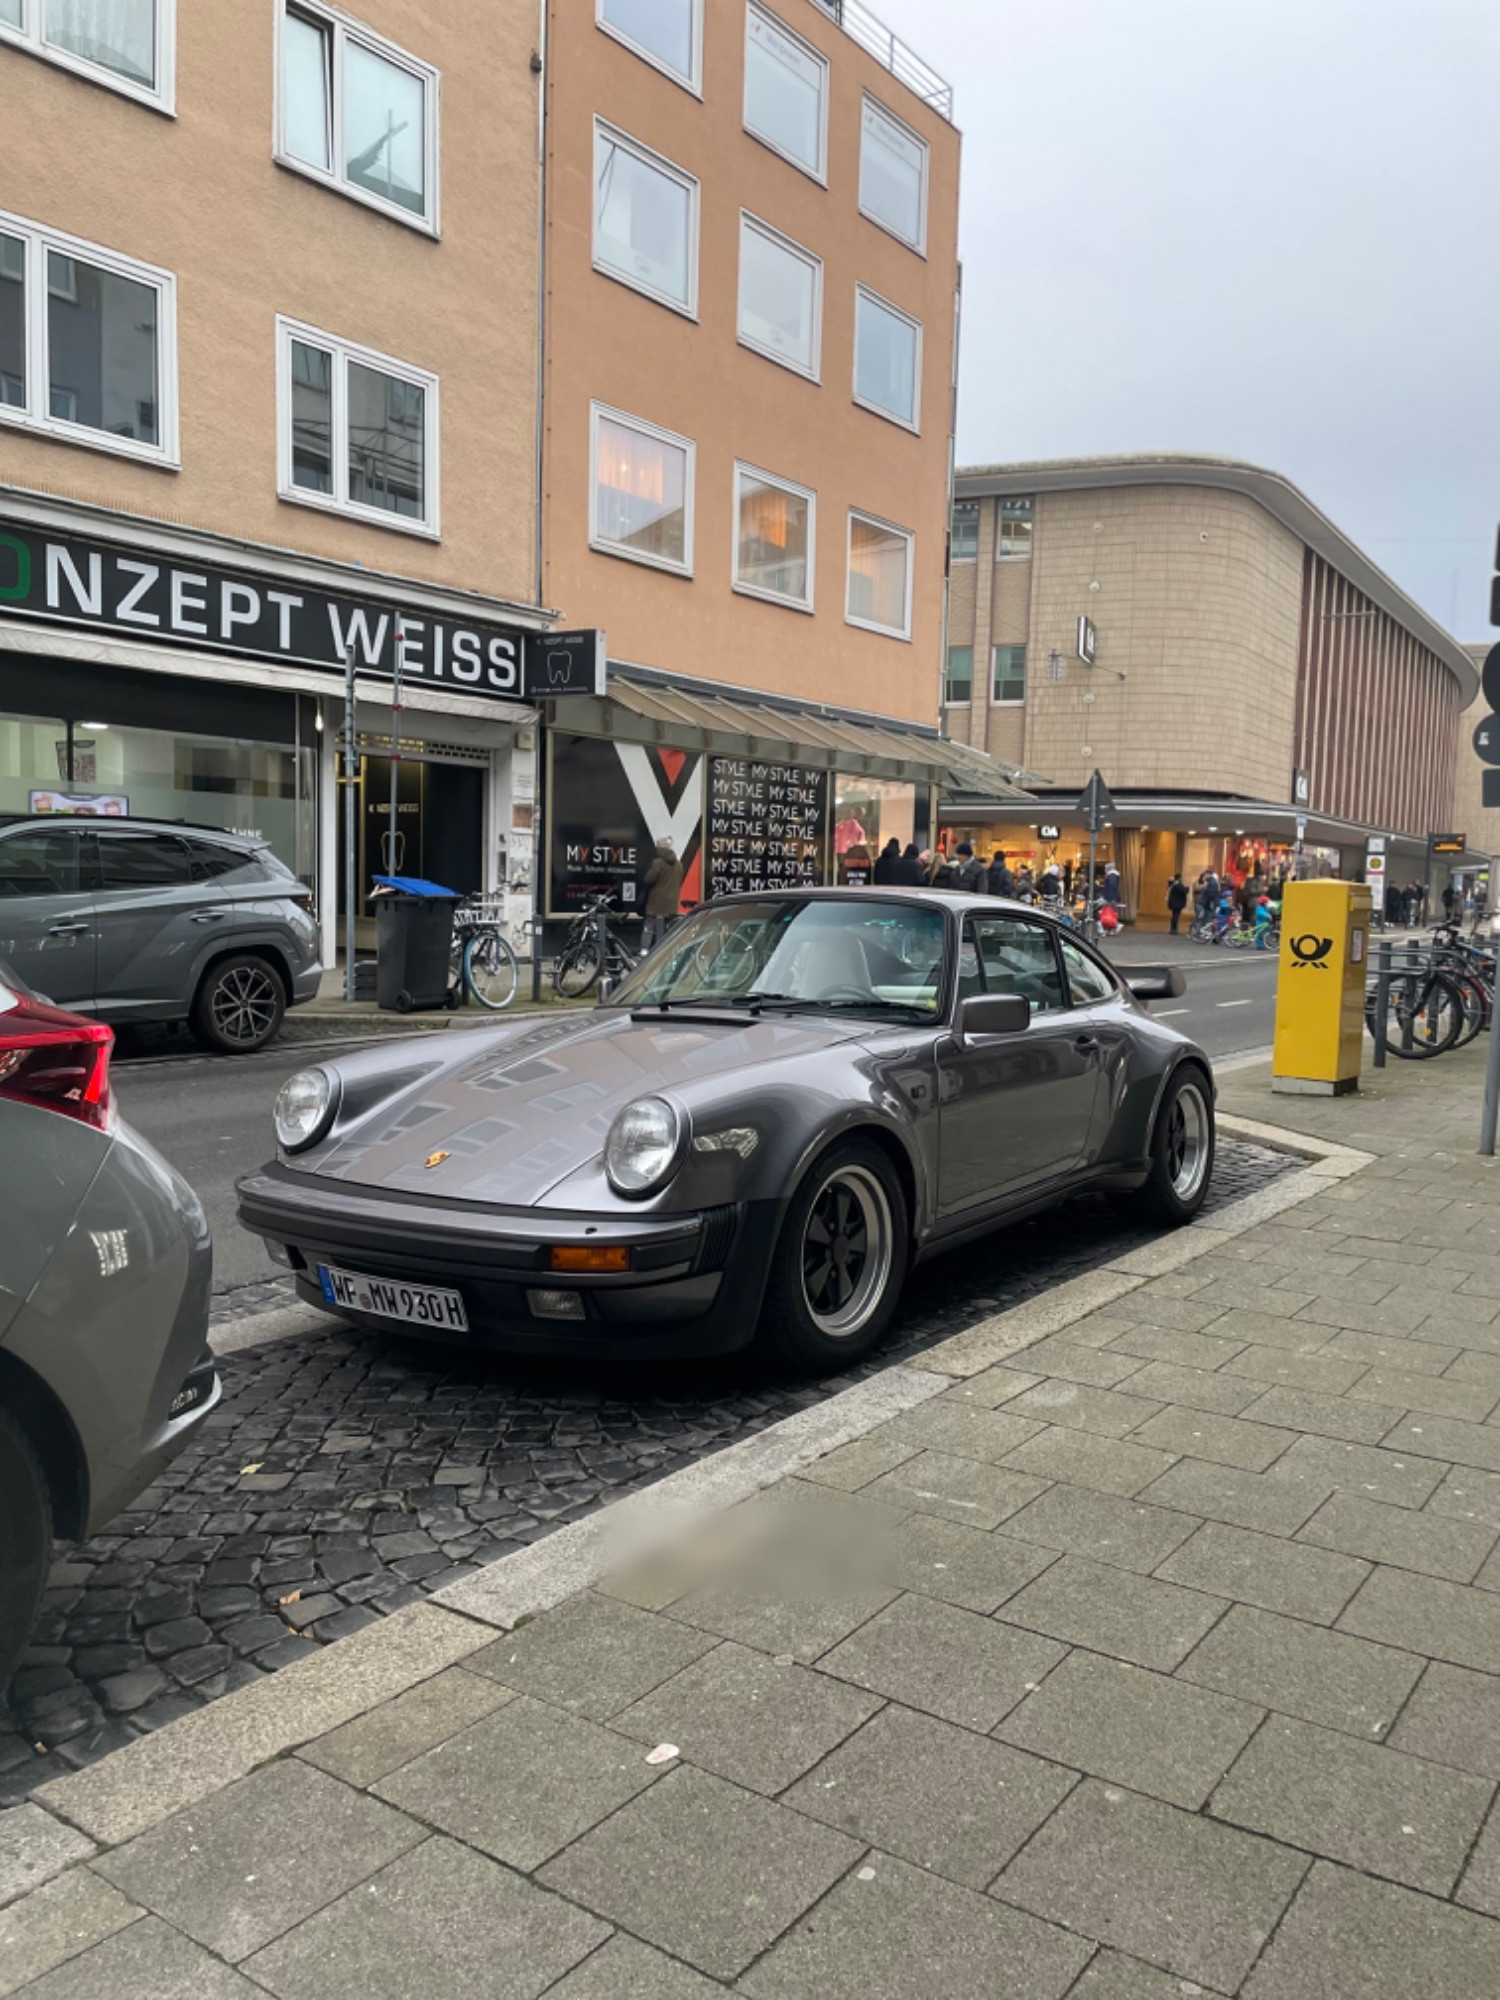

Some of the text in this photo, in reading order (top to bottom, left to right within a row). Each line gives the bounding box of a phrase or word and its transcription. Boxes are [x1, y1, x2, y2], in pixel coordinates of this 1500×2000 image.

[327, 602, 516, 687] WEISS
[714, 759, 746, 776] STYLE
[751, 764, 768, 779] MY
[770, 766, 799, 783] STYLE
[713, 779, 816, 804] MY STYLE MY STYLE
[713, 798, 819, 822] STYLE MY STYLE MY
[712, 818, 814, 840] MY STYLE MY STYLE
[567, 845, 636, 864] MY STYLE
[712, 837, 745, 854] STYLE
[750, 840, 766, 855] MY
[768, 841, 798, 857] STYLE
[712, 857, 813, 876] MY STYLE MY STYLE
[331, 1273, 356, 1304] WF
[369, 1283, 399, 1315] MW
